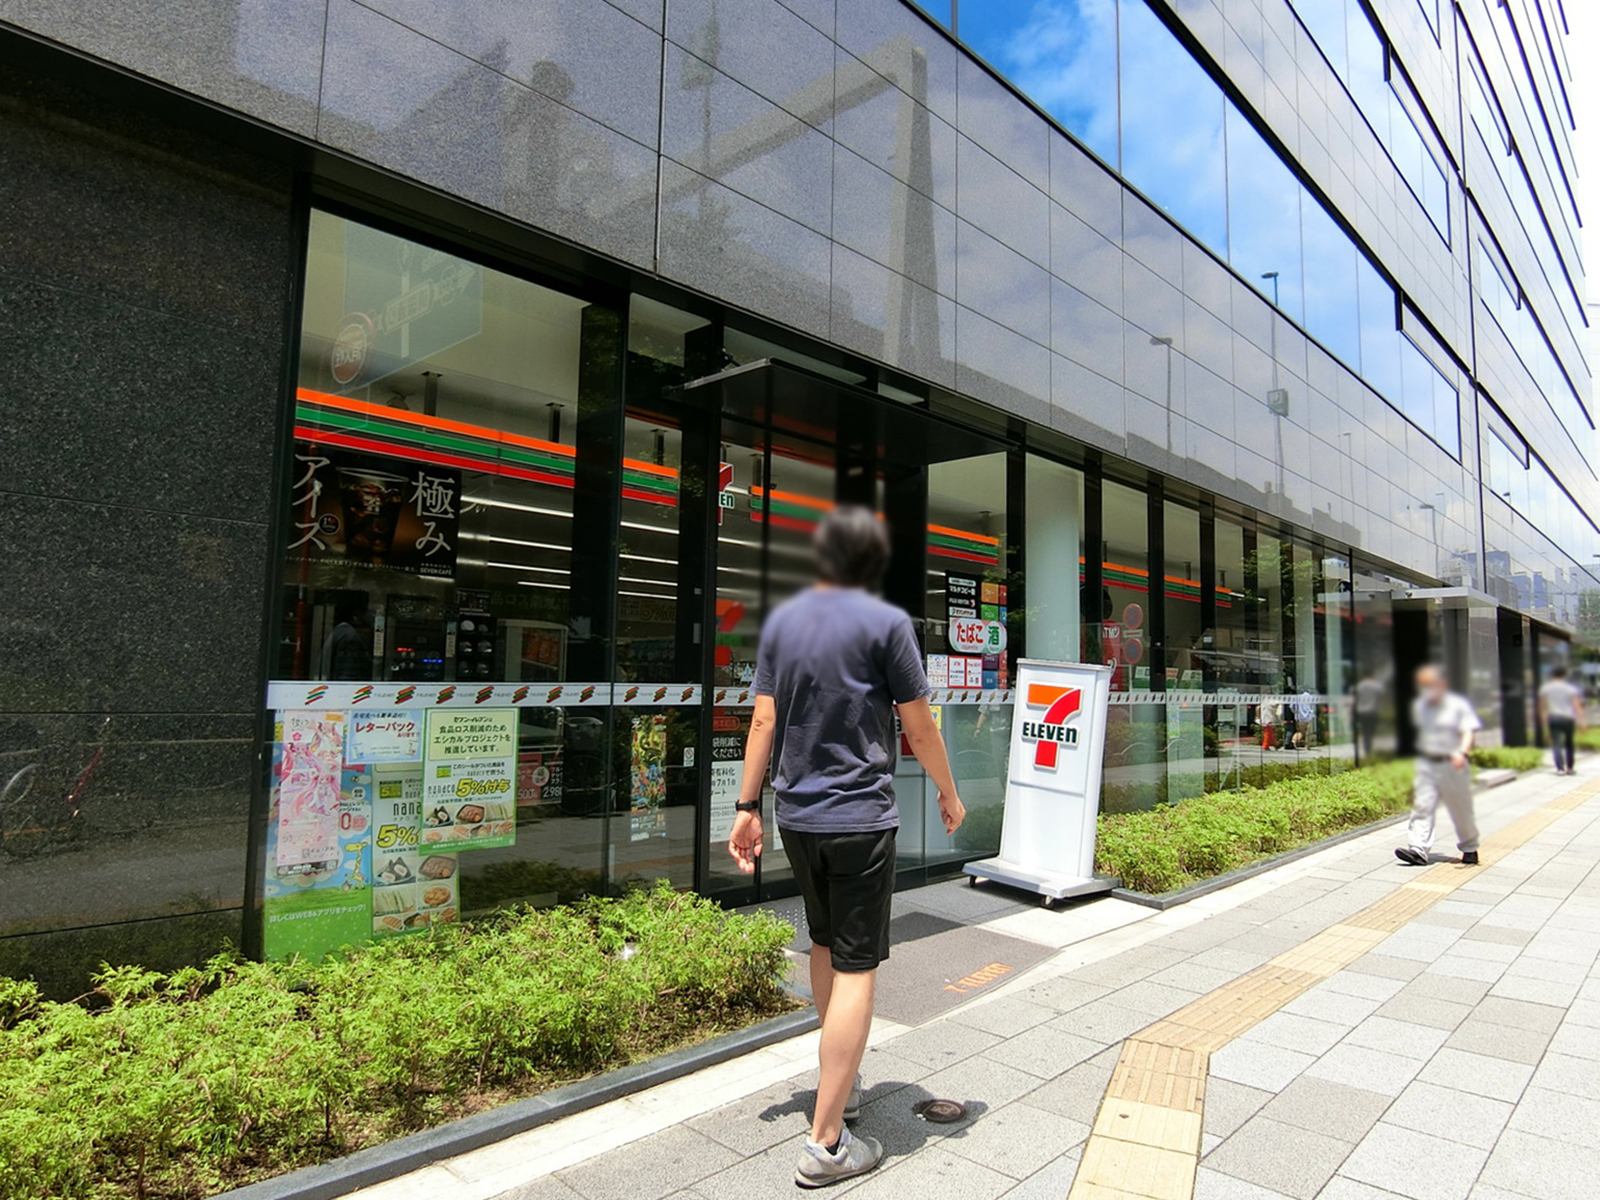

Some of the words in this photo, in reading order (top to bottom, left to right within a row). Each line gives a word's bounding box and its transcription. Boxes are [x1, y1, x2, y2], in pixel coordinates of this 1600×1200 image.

[288, 454, 331, 551] アイス
[408, 471, 456, 557] 極み
[956, 622, 984, 644] たばこ
[987, 625, 1000, 646] 酒
[355, 721, 415, 733] レターパック
[439, 723, 507, 735] 食品ロス削減のため
[1027, 683, 1081, 767] 7
[433, 733, 511, 744] エシカルプロジェクトを
[444, 745, 500, 755] 推進しています。
[712, 748, 742, 758] ください
[455, 777, 512, 797] 5%付与
[393, 802, 421, 816] nana
[376, 824, 419, 848] 5%
